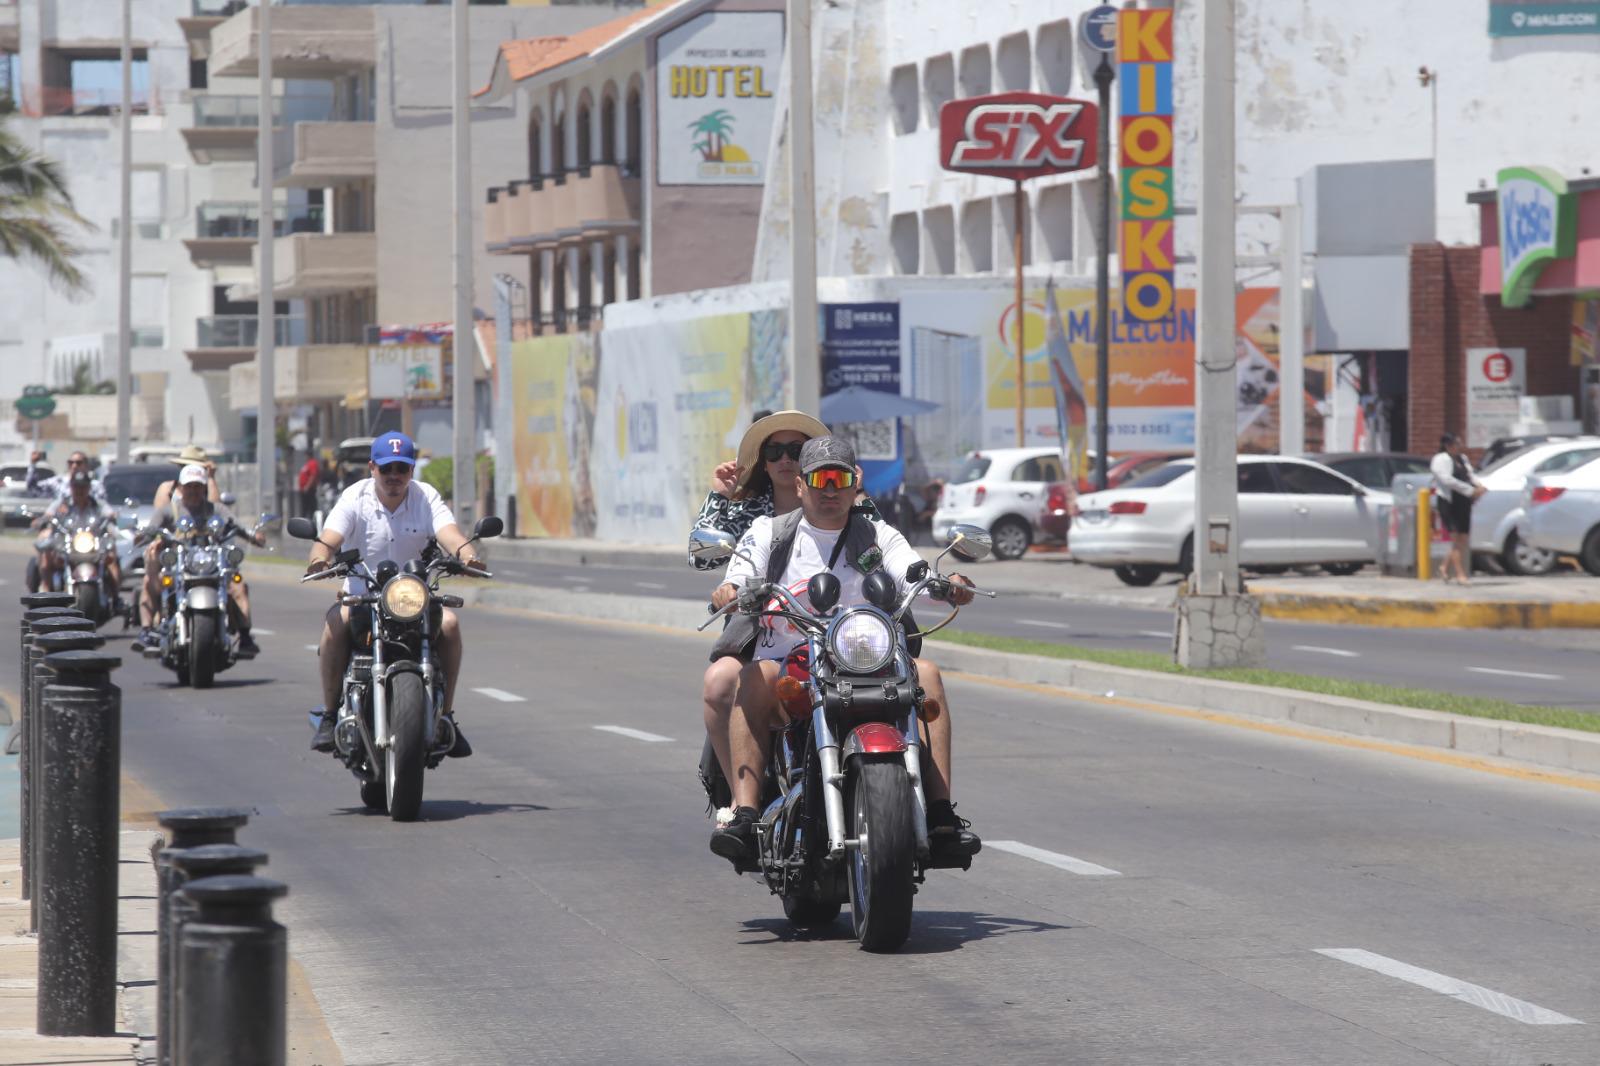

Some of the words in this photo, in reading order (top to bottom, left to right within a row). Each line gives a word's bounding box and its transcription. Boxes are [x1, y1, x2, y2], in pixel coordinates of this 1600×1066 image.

[670, 65, 773, 98] HOTEL
[1121, 10, 1173, 321] KIOSKO
[1489, 358, 1507, 379] E
[388, 438, 402, 455] T
